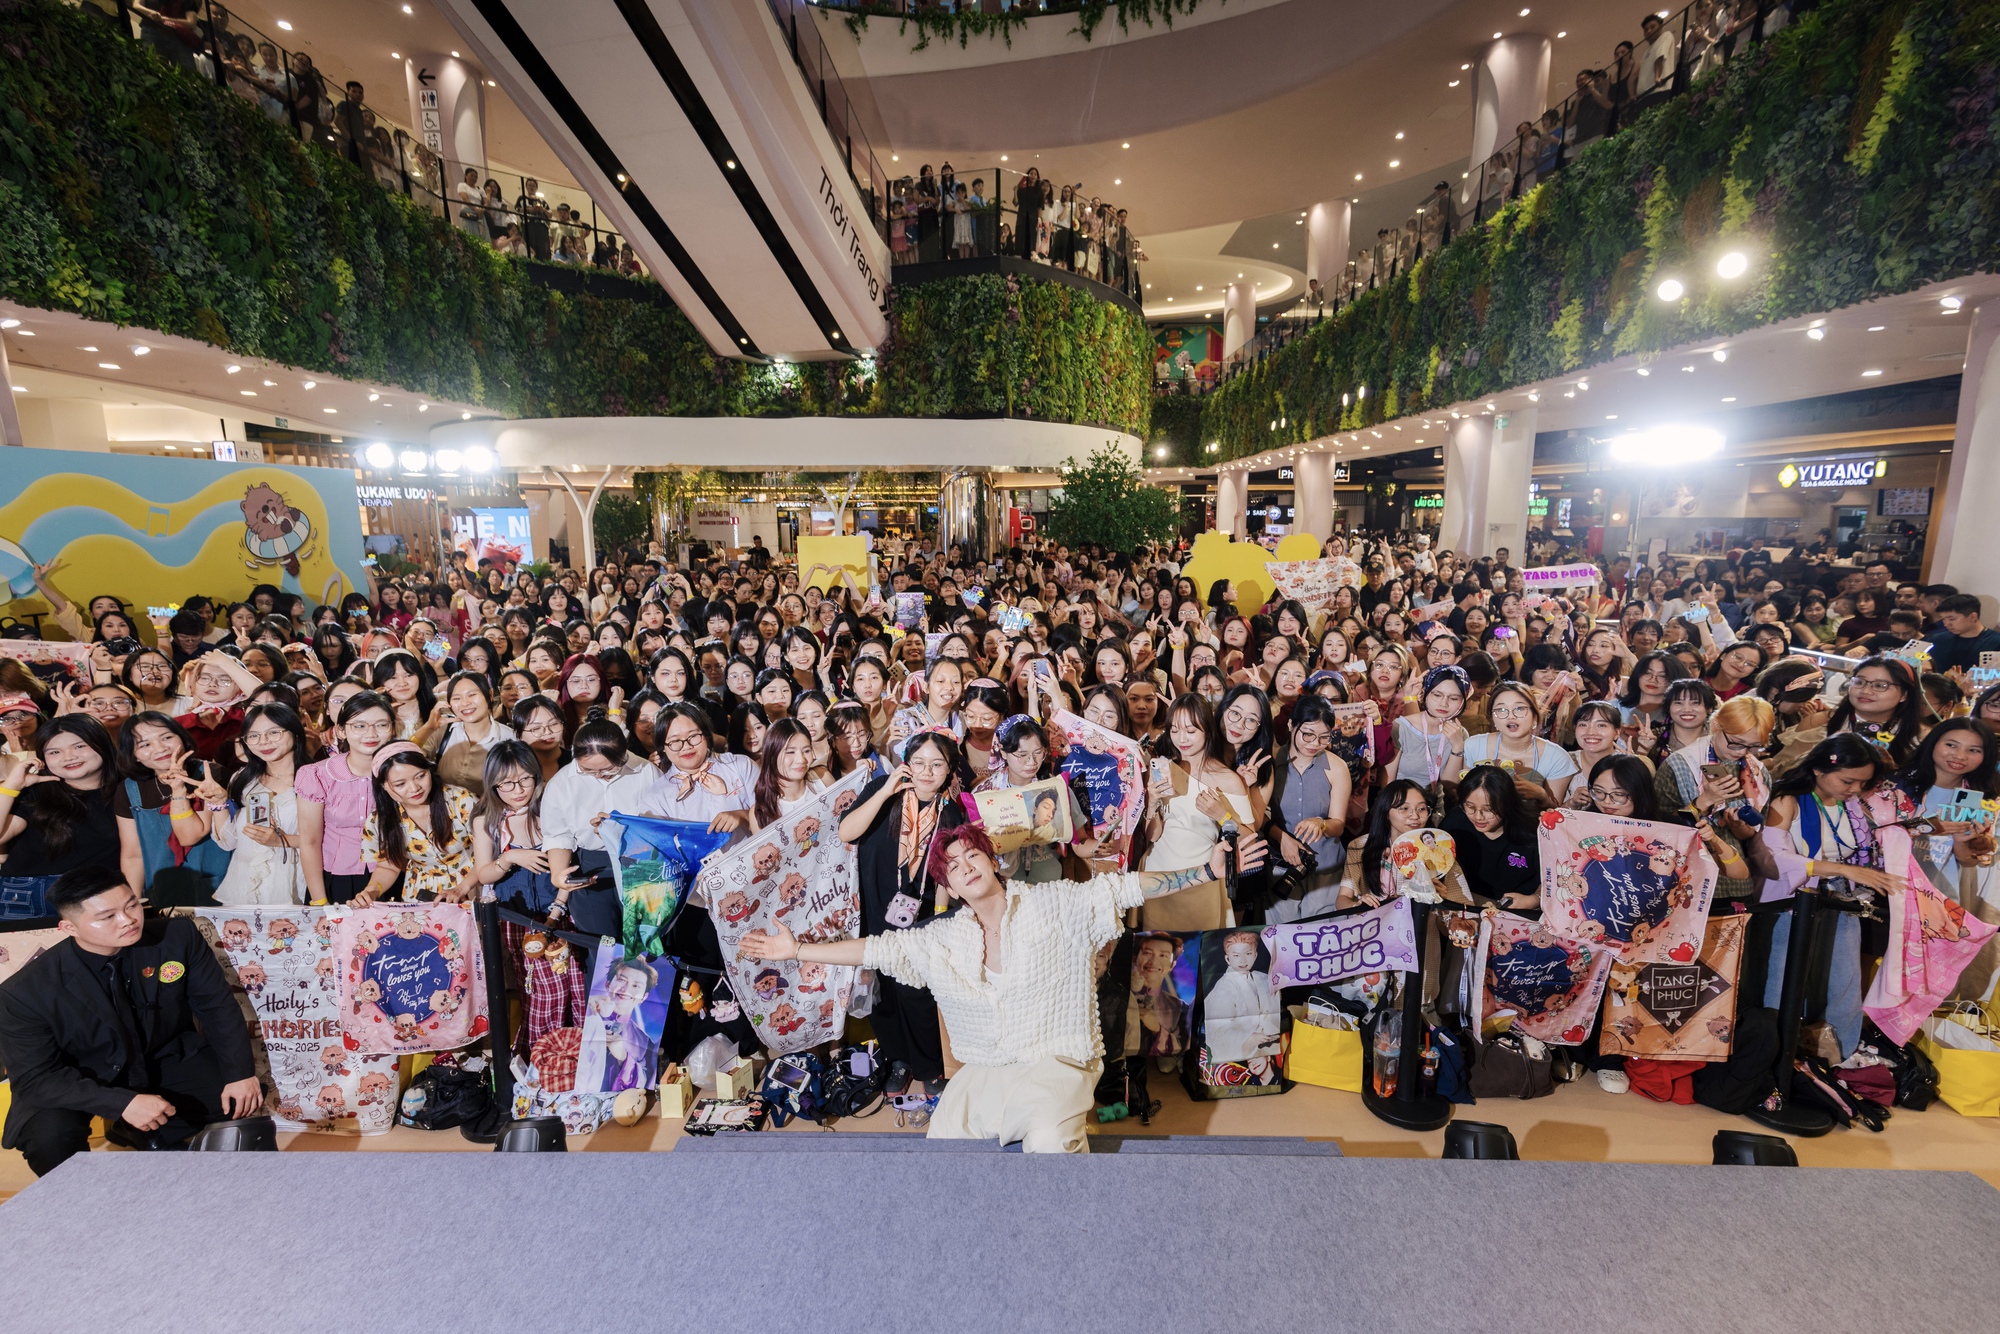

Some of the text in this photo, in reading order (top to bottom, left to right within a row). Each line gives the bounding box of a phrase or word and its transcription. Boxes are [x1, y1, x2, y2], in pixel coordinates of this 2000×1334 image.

[819, 165, 879, 301] Thời Trang
[1798, 461, 1874, 481] YUTANG
[363, 499, 393, 507] TEMPURA
[147, 606, 178, 618] TUMP
[1095, 779, 1110, 790] you
[1610, 818, 1635, 826] THANK
[805, 872, 851, 920] Haily'
[1626, 872, 1641, 918] loves you
[1697, 878, 1710, 913] BEAVER DAM
[1293, 917, 1381, 957] TĂNG
[372, 946, 438, 980] tump
[1295, 940, 1386, 982] PHÚC
[1497, 958, 1566, 978] tump
[387, 966, 431, 986] loves you
[1511, 974, 1554, 986] loves you
[1655, 975, 1695, 987] TANG
[257, 990, 319, 1018] Haily's
[1657, 989, 1693, 1001] PHUC
[248, 1019, 341, 1040] EMORIES
[261, 1043, 287, 1052] 2024
[295, 1042, 320, 1052] 2025
